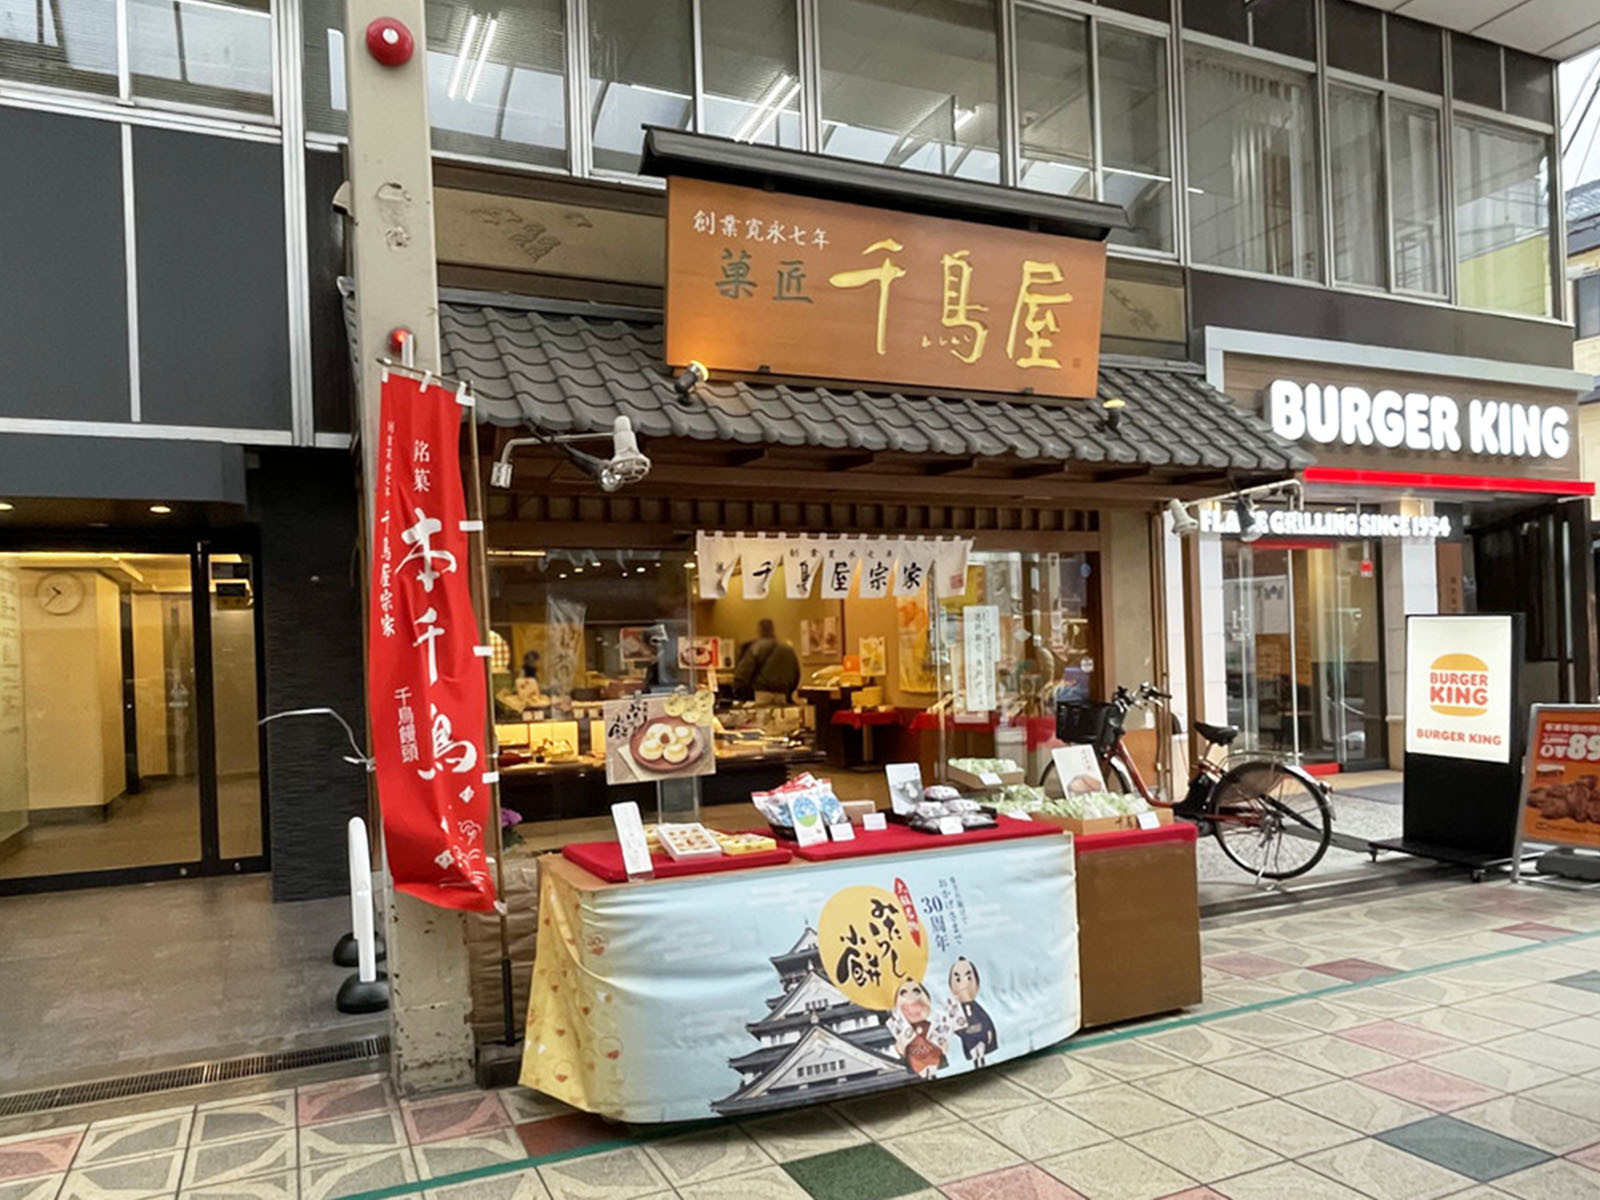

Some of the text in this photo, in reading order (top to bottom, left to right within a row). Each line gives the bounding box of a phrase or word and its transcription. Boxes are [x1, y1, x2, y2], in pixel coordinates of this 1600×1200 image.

[715, 237, 1074, 370] 菓匠 千鳥屋
[1269, 378, 1571, 460] BURGER KING
[1200, 509, 1452, 538] FLAE GRILLING SINCE 1954
[1430, 672, 1489, 687] BURGER
[1430, 686, 1489, 706] KING
[1416, 728, 1502, 746] BURGER KING
